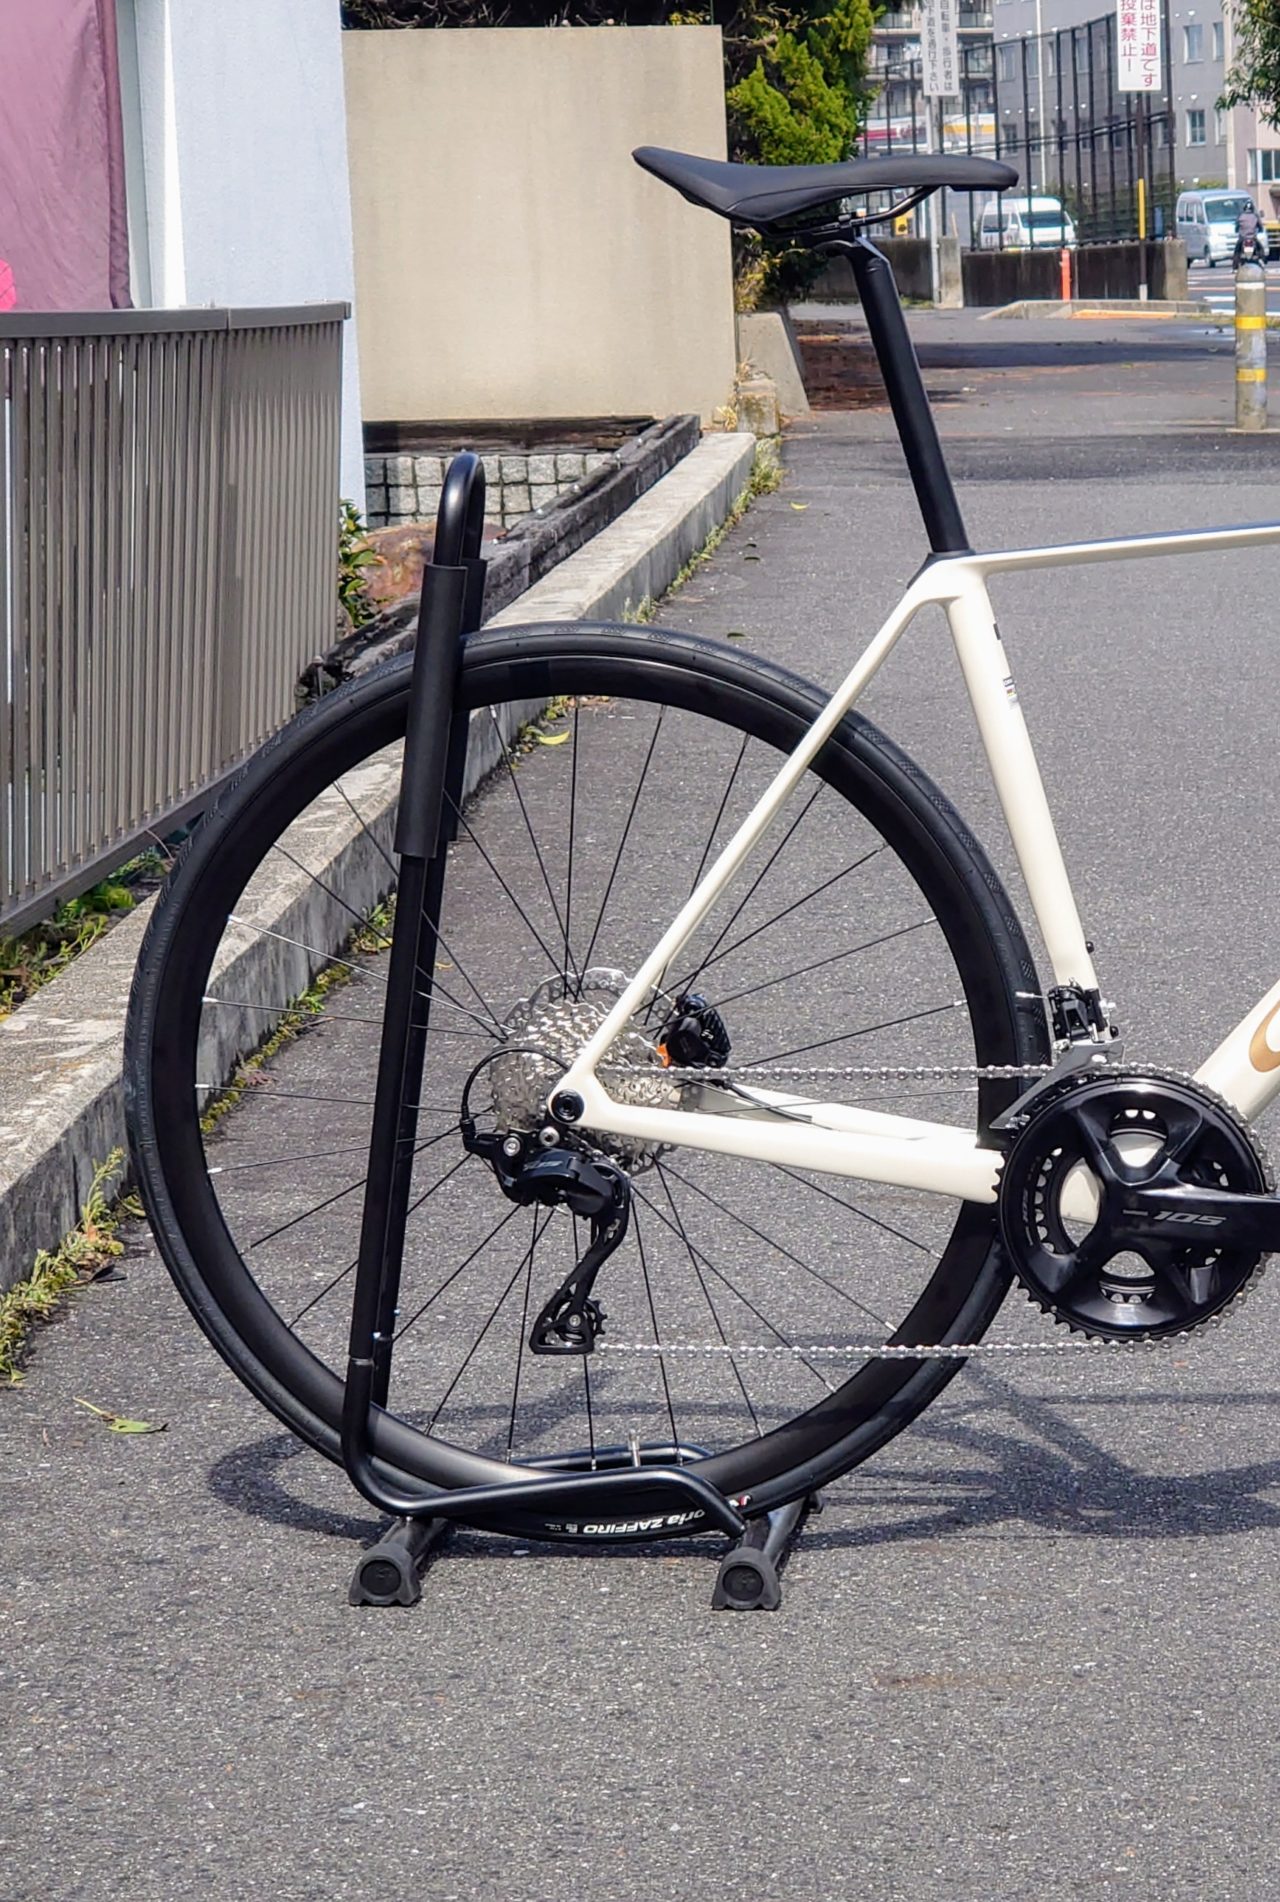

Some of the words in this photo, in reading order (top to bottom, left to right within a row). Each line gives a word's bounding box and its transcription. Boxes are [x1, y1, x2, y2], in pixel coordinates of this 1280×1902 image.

[1140, 0, 1159, 87] は地下道です
[1153, 1210, 1226, 1226] 105
[583, 1517, 664, 1534] ZAFFIRO
